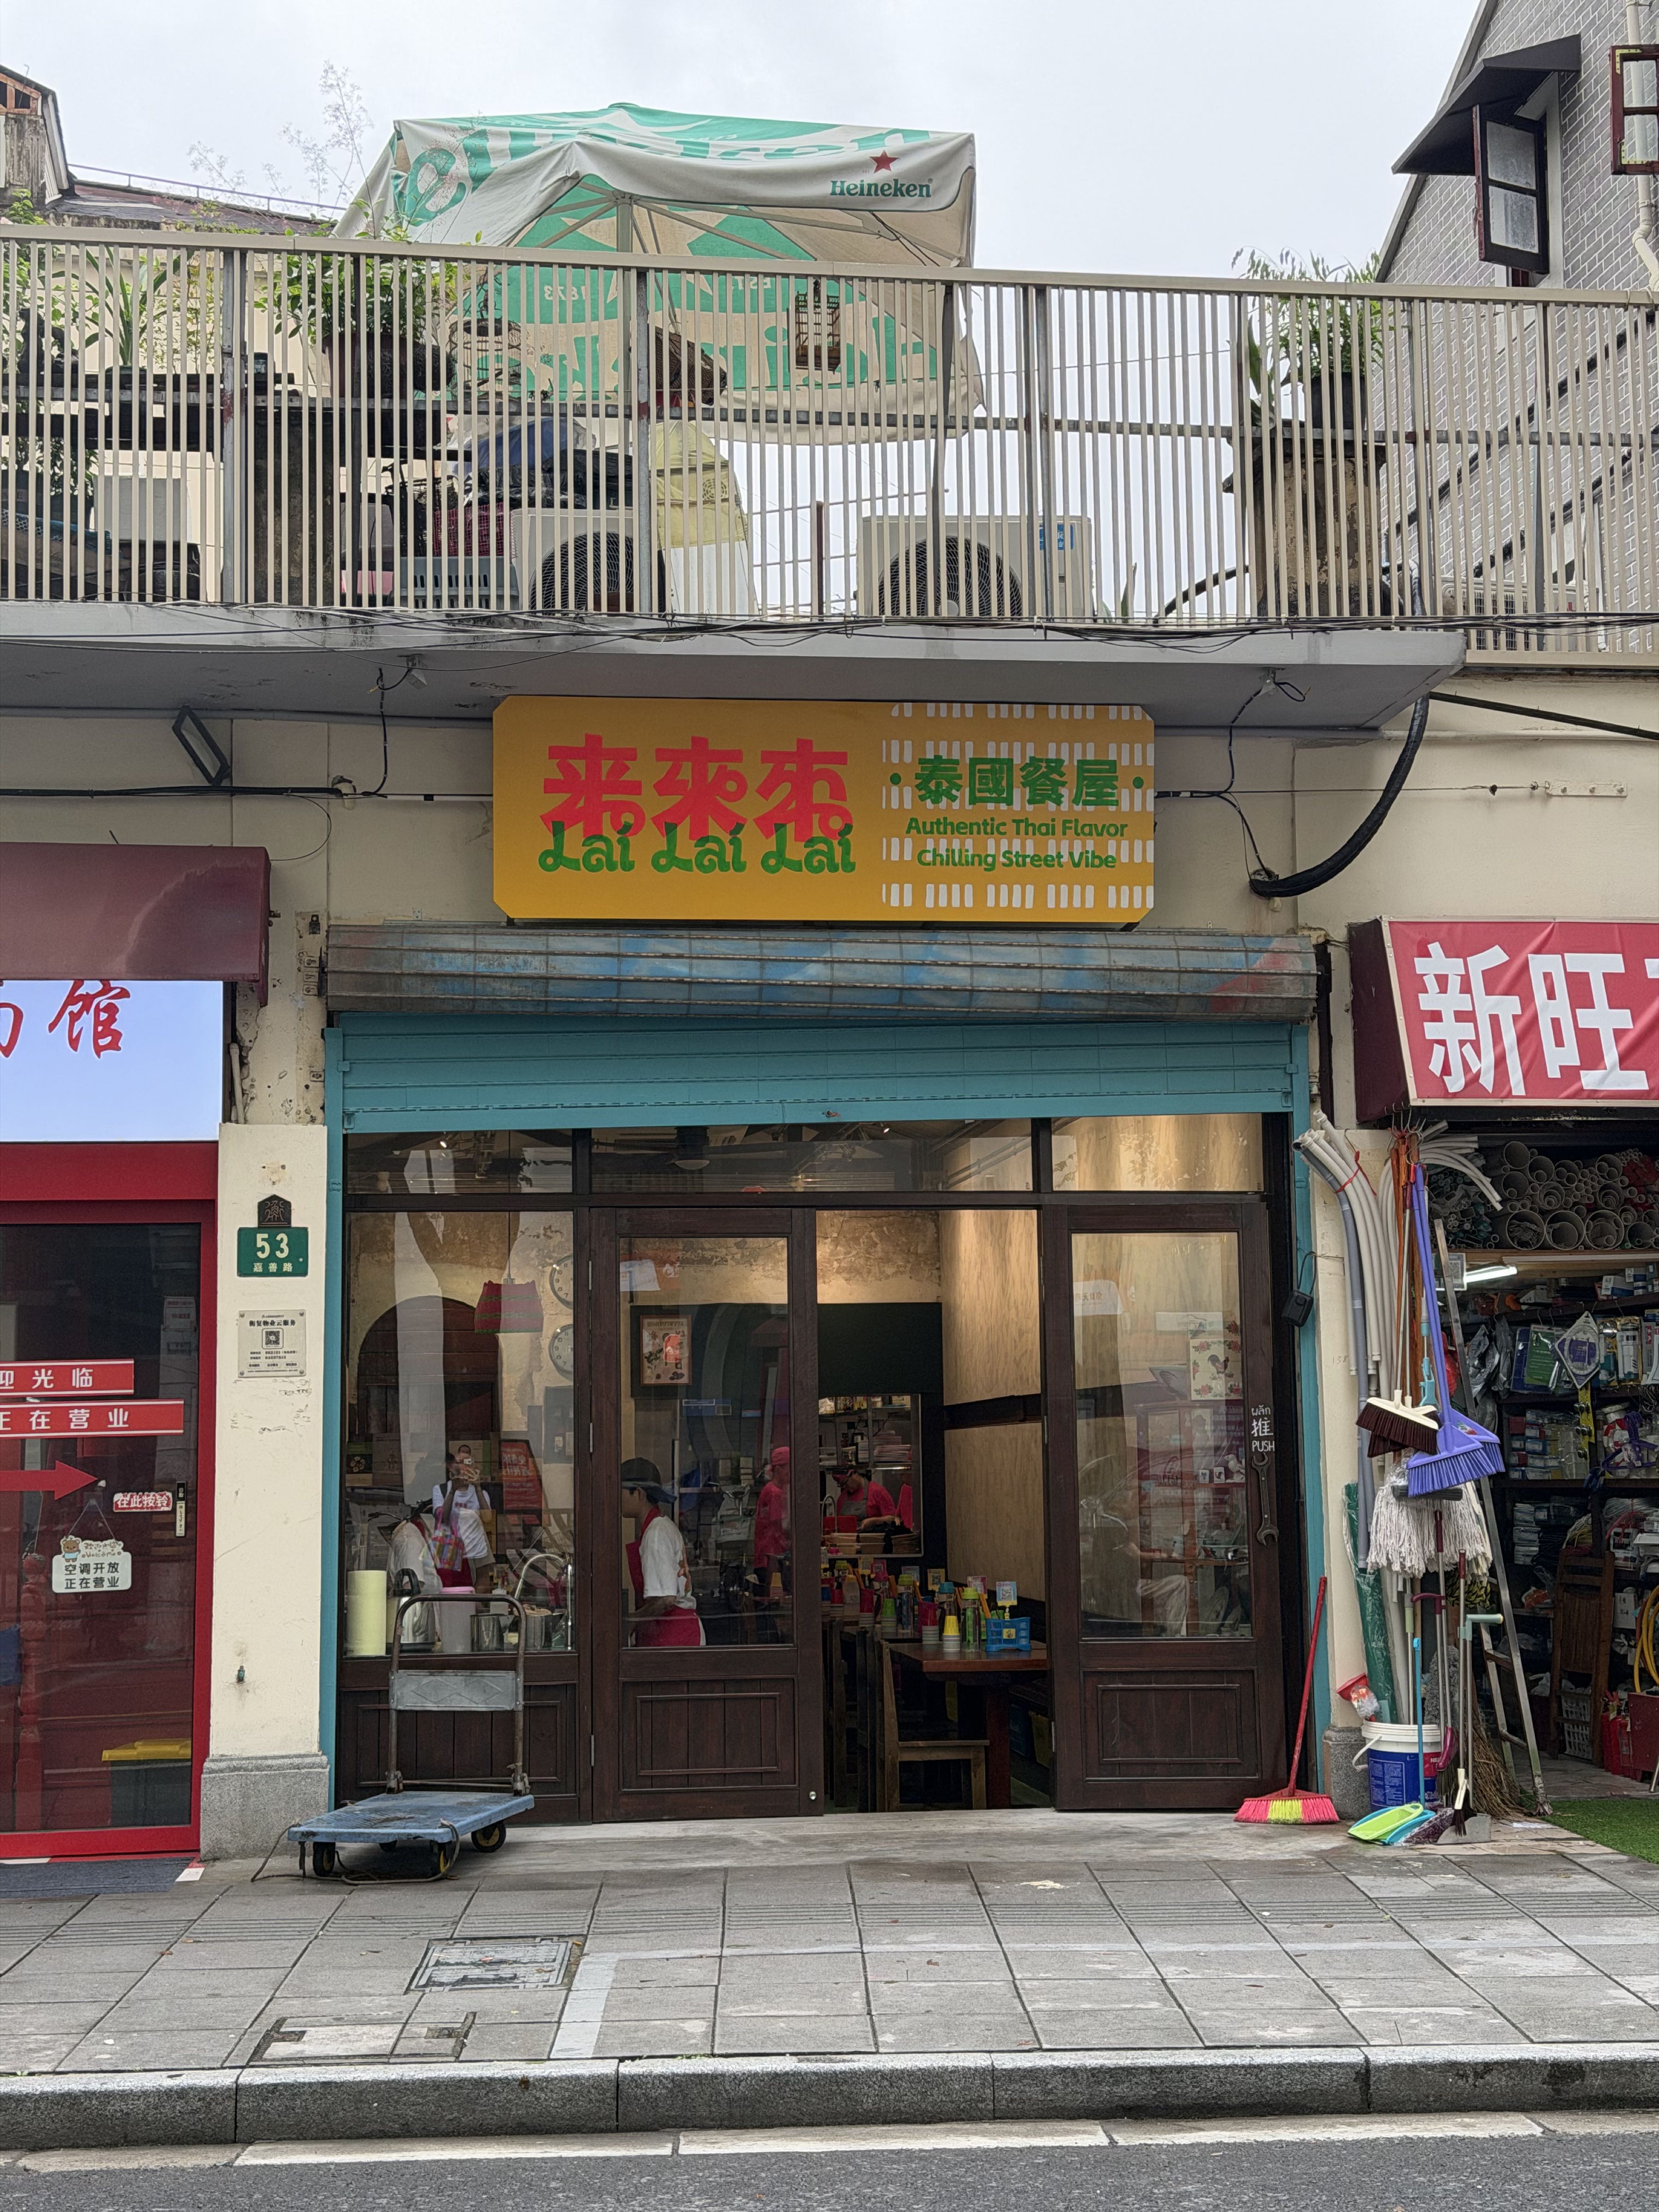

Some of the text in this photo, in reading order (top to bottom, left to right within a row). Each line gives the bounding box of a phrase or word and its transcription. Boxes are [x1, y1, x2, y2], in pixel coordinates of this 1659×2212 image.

[830, 178, 932, 198] Heineken
[915, 755, 1119, 806] 泰國餐屋
[906, 817, 1128, 837] Authentic Thai Flavor
[538, 821, 856, 874] Lai Lai Lai
[917, 847, 1117, 872] Chilling Street Vibe
[0, 980, 131, 1059] 馆
[1413, 941, 1659, 1096] 新旺
[256, 1233, 289, 1259] 53
[253, 1262, 294, 1273] 嘉善路
[1251, 1418, 1274, 1437] 推
[1252, 1440, 1275, 1452] PUSH
[64, 1561, 120, 1576] 空调开放
[64, 1576, 120, 1589] 正在营业
